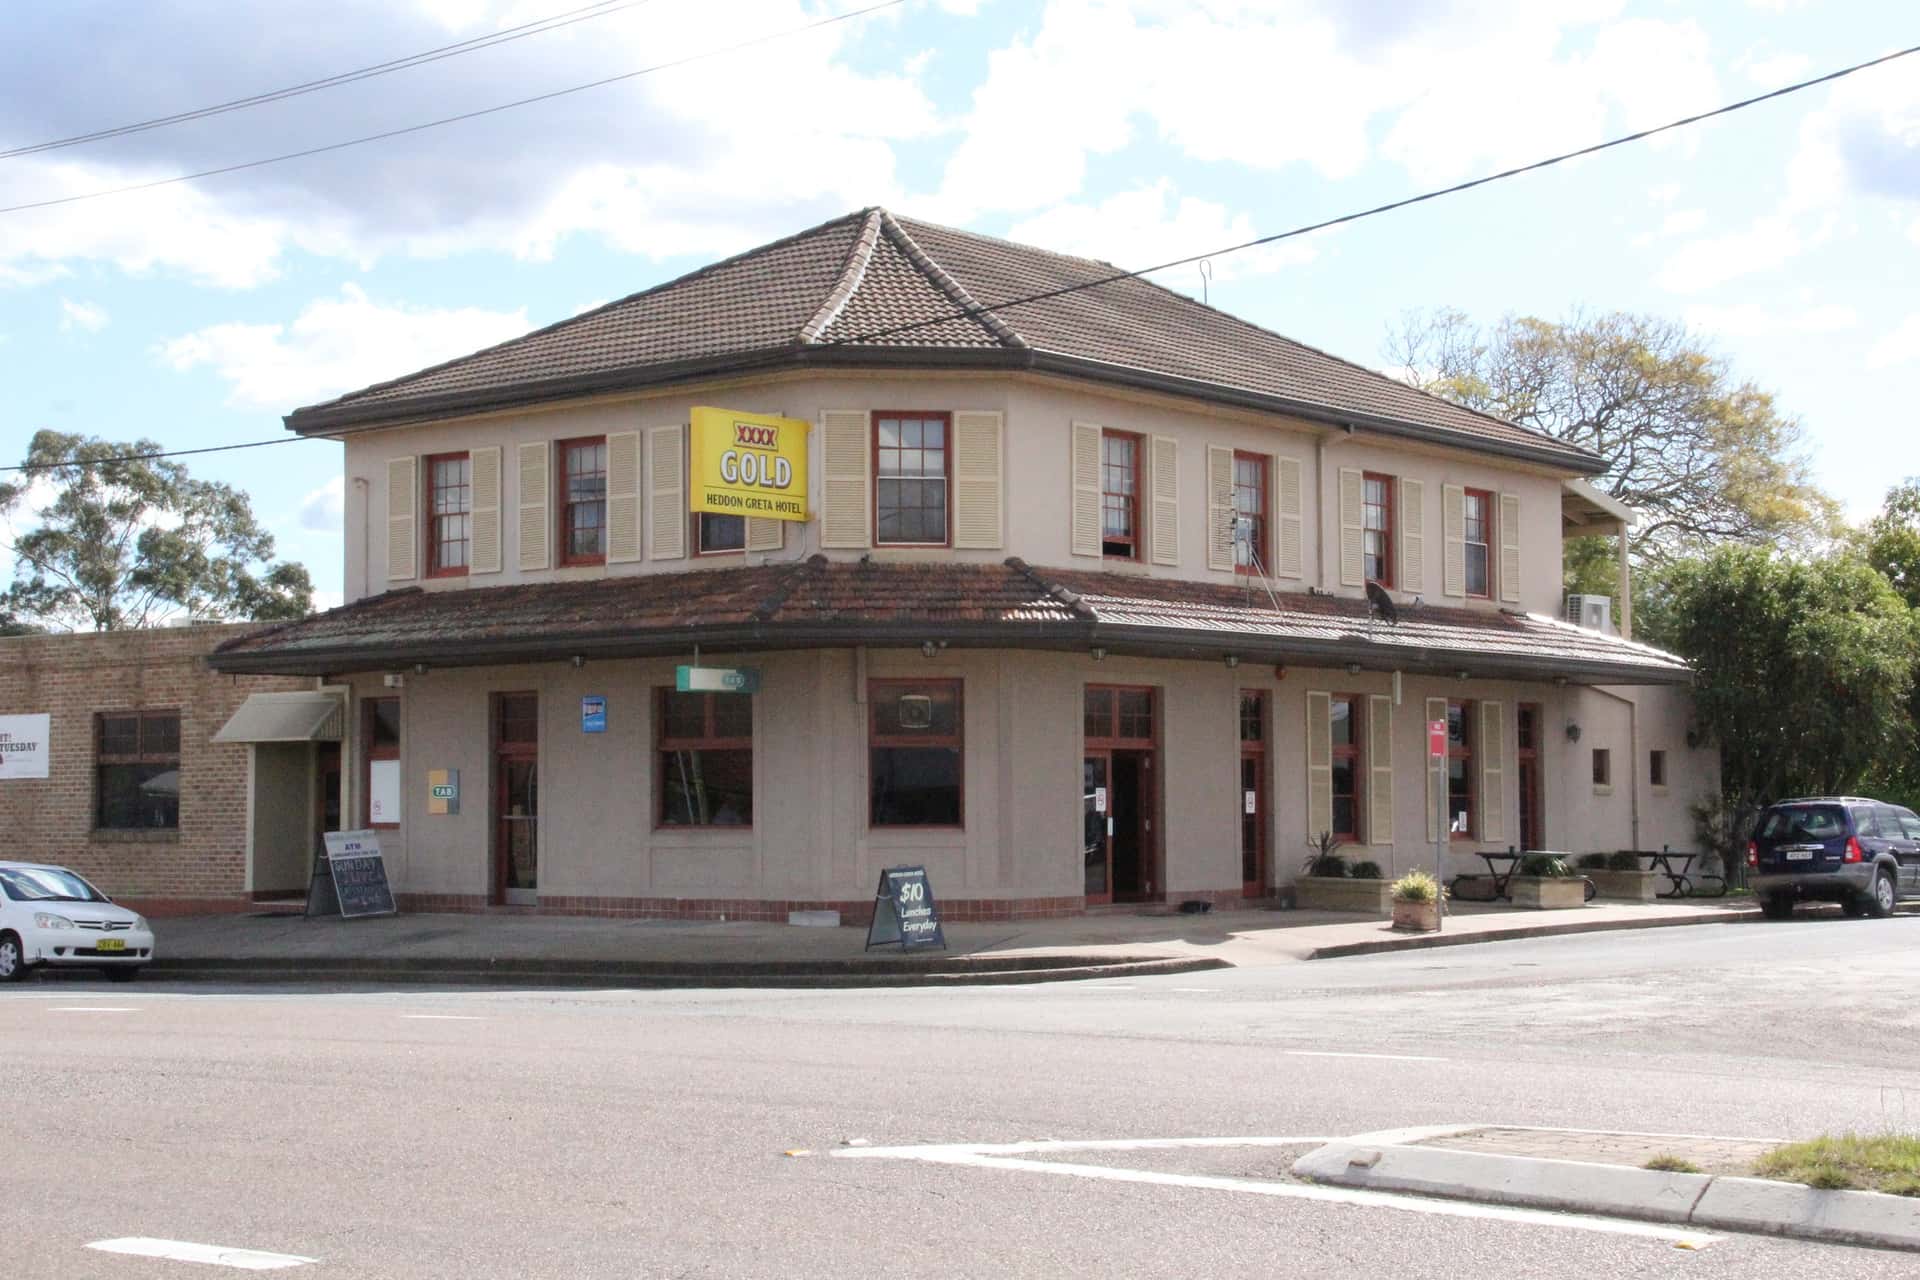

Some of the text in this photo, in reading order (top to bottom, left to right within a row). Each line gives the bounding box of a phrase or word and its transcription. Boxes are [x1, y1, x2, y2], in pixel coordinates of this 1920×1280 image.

[737, 425, 775, 447] XXXX
[720, 450, 792, 489] GOLD
[706, 493, 802, 514] HEDDON GRETA HOTEL
[0, 743, 37, 752] TUESDAY
[435, 787, 452, 796] TAB
[900, 881, 924, 904] $10
[901, 905, 932, 918] Lunches
[903, 918, 937, 933] Everyday
